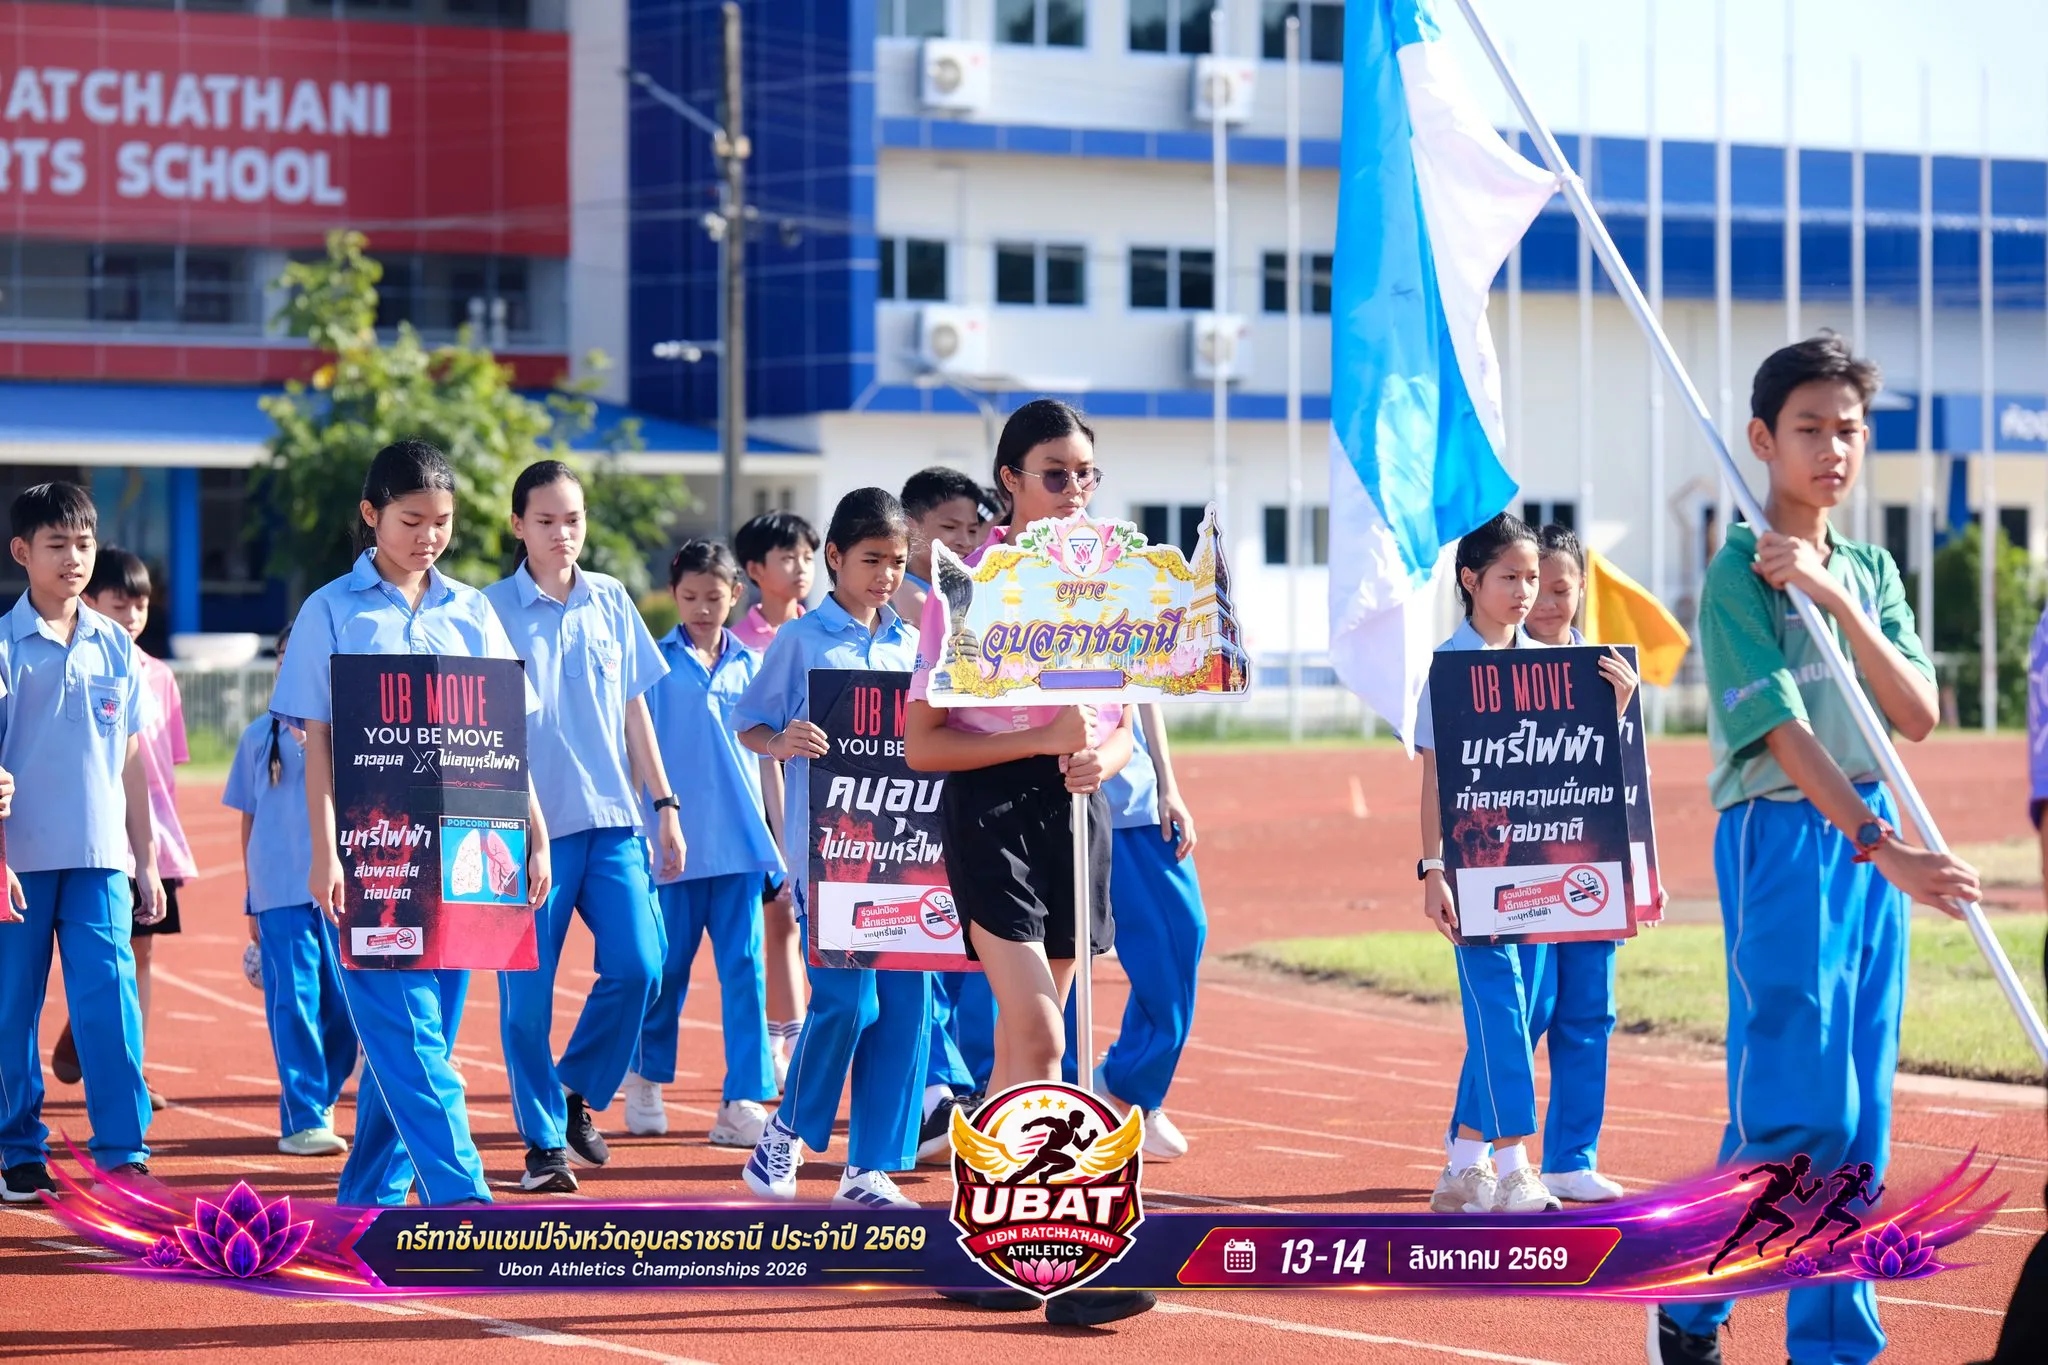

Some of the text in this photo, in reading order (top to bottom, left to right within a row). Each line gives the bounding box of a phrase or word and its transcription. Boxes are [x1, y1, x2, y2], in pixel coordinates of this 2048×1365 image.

[0, 66, 391, 137] ATCHATHANI
[115, 140, 346, 206] SCHOOL
[1056, 580, 1108, 607] อนุบาล
[981, 607, 1187, 682] อุบลราชธานี
[380, 672, 488, 727] UB MOVE
[1471, 662, 1575, 713] UB MOVE
[853, 687, 882, 737] UB
[364, 727, 503, 748] YOU BE MOVE
[837, 737, 905, 757] YOU BE
[1461, 718, 1605, 783] บุหรี่ไฟฟ้า
[353, 754, 404, 772] ชาวอุบล
[826, 776, 945, 836] คนอุบ
[1456, 776, 1615, 811] ทำลายความมั่นคง
[339, 819, 432, 857] บุหรี่ไฟฟ้า
[447, 818, 519, 829] POPCORN LUNGS
[1496, 817, 1584, 844] ของชาติ
[819, 826, 944, 873] ไม่เอาบุหรี่ไฟ
[363, 883, 412, 900] ต่อปอด
